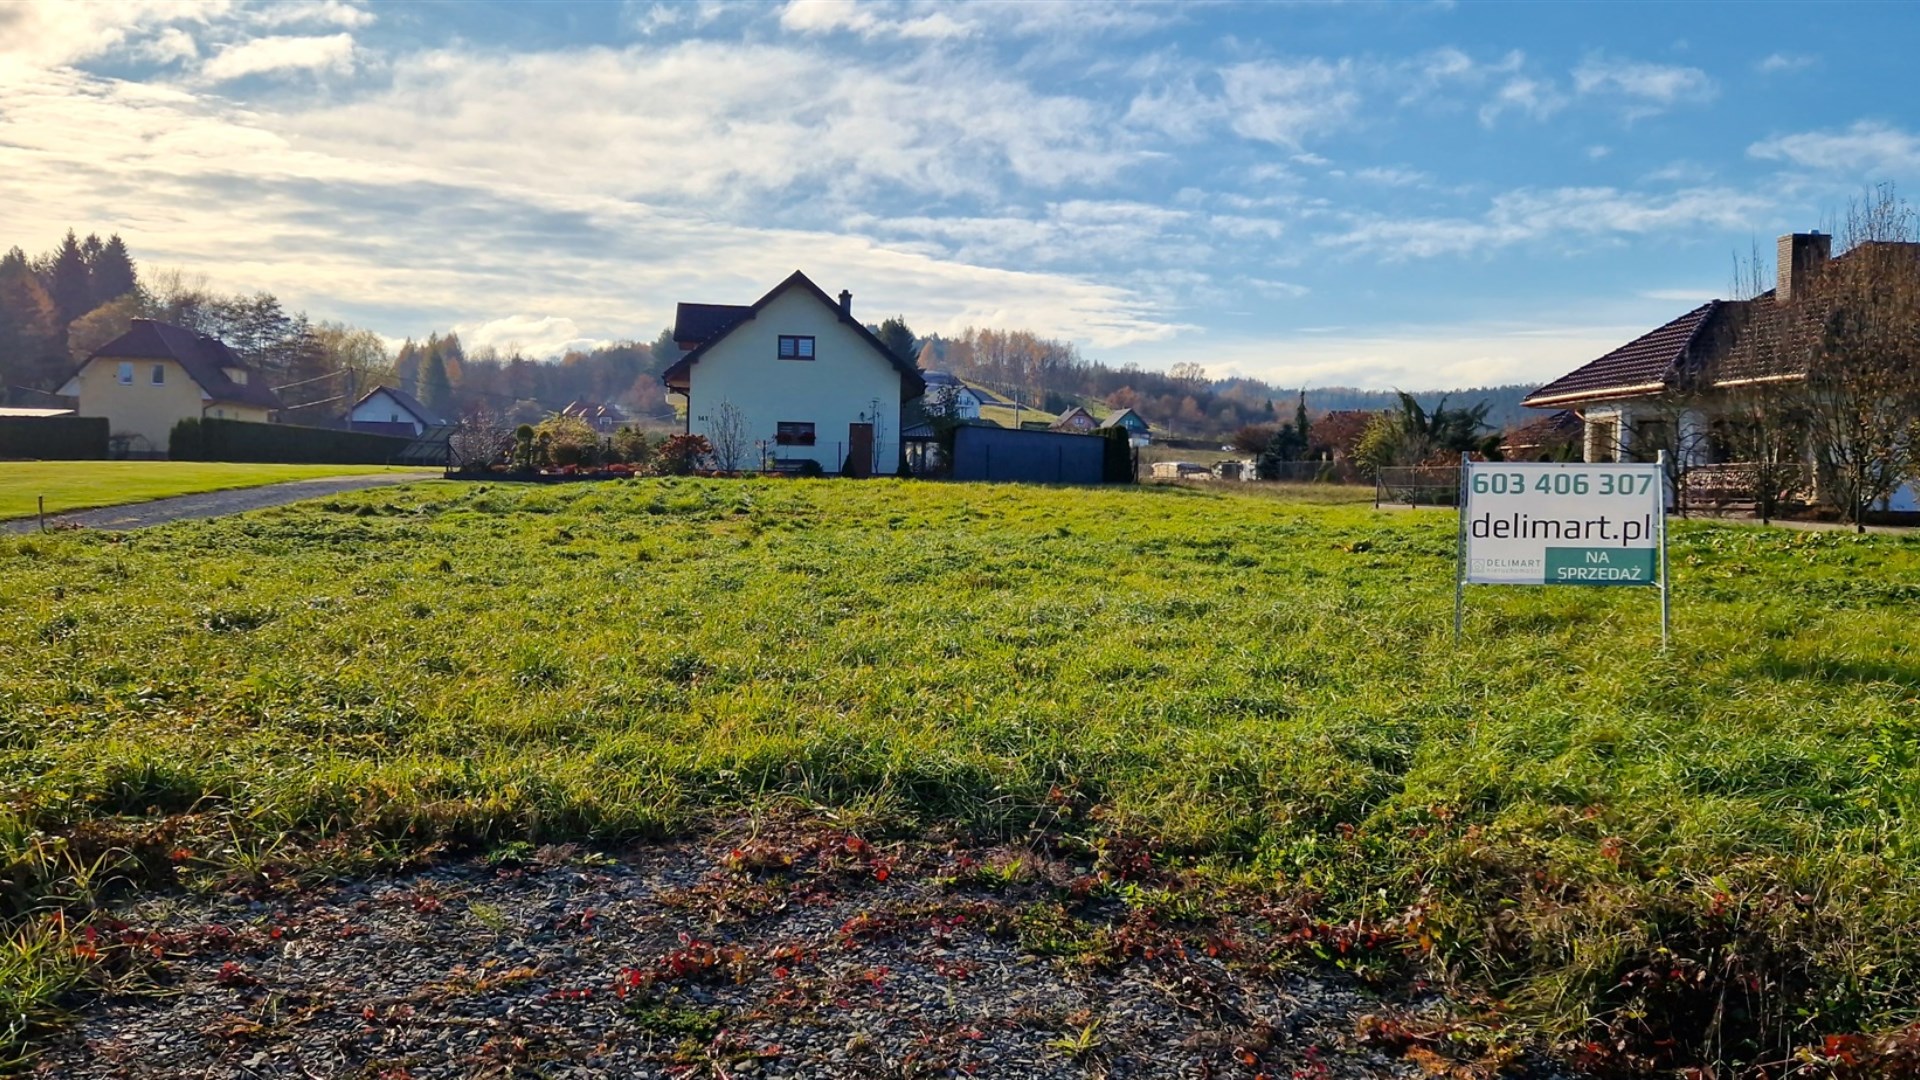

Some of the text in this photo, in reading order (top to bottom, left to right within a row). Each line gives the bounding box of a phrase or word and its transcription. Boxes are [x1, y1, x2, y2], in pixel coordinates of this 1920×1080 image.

[1473, 473, 1653, 495] 603 406 307
[1472, 512, 1650, 546] delimart.pl
[1486, 559, 1541, 568] DELIMART
[1586, 551, 1610, 563] NA
[1557, 565, 1642, 580] SPRZEDAŻ
